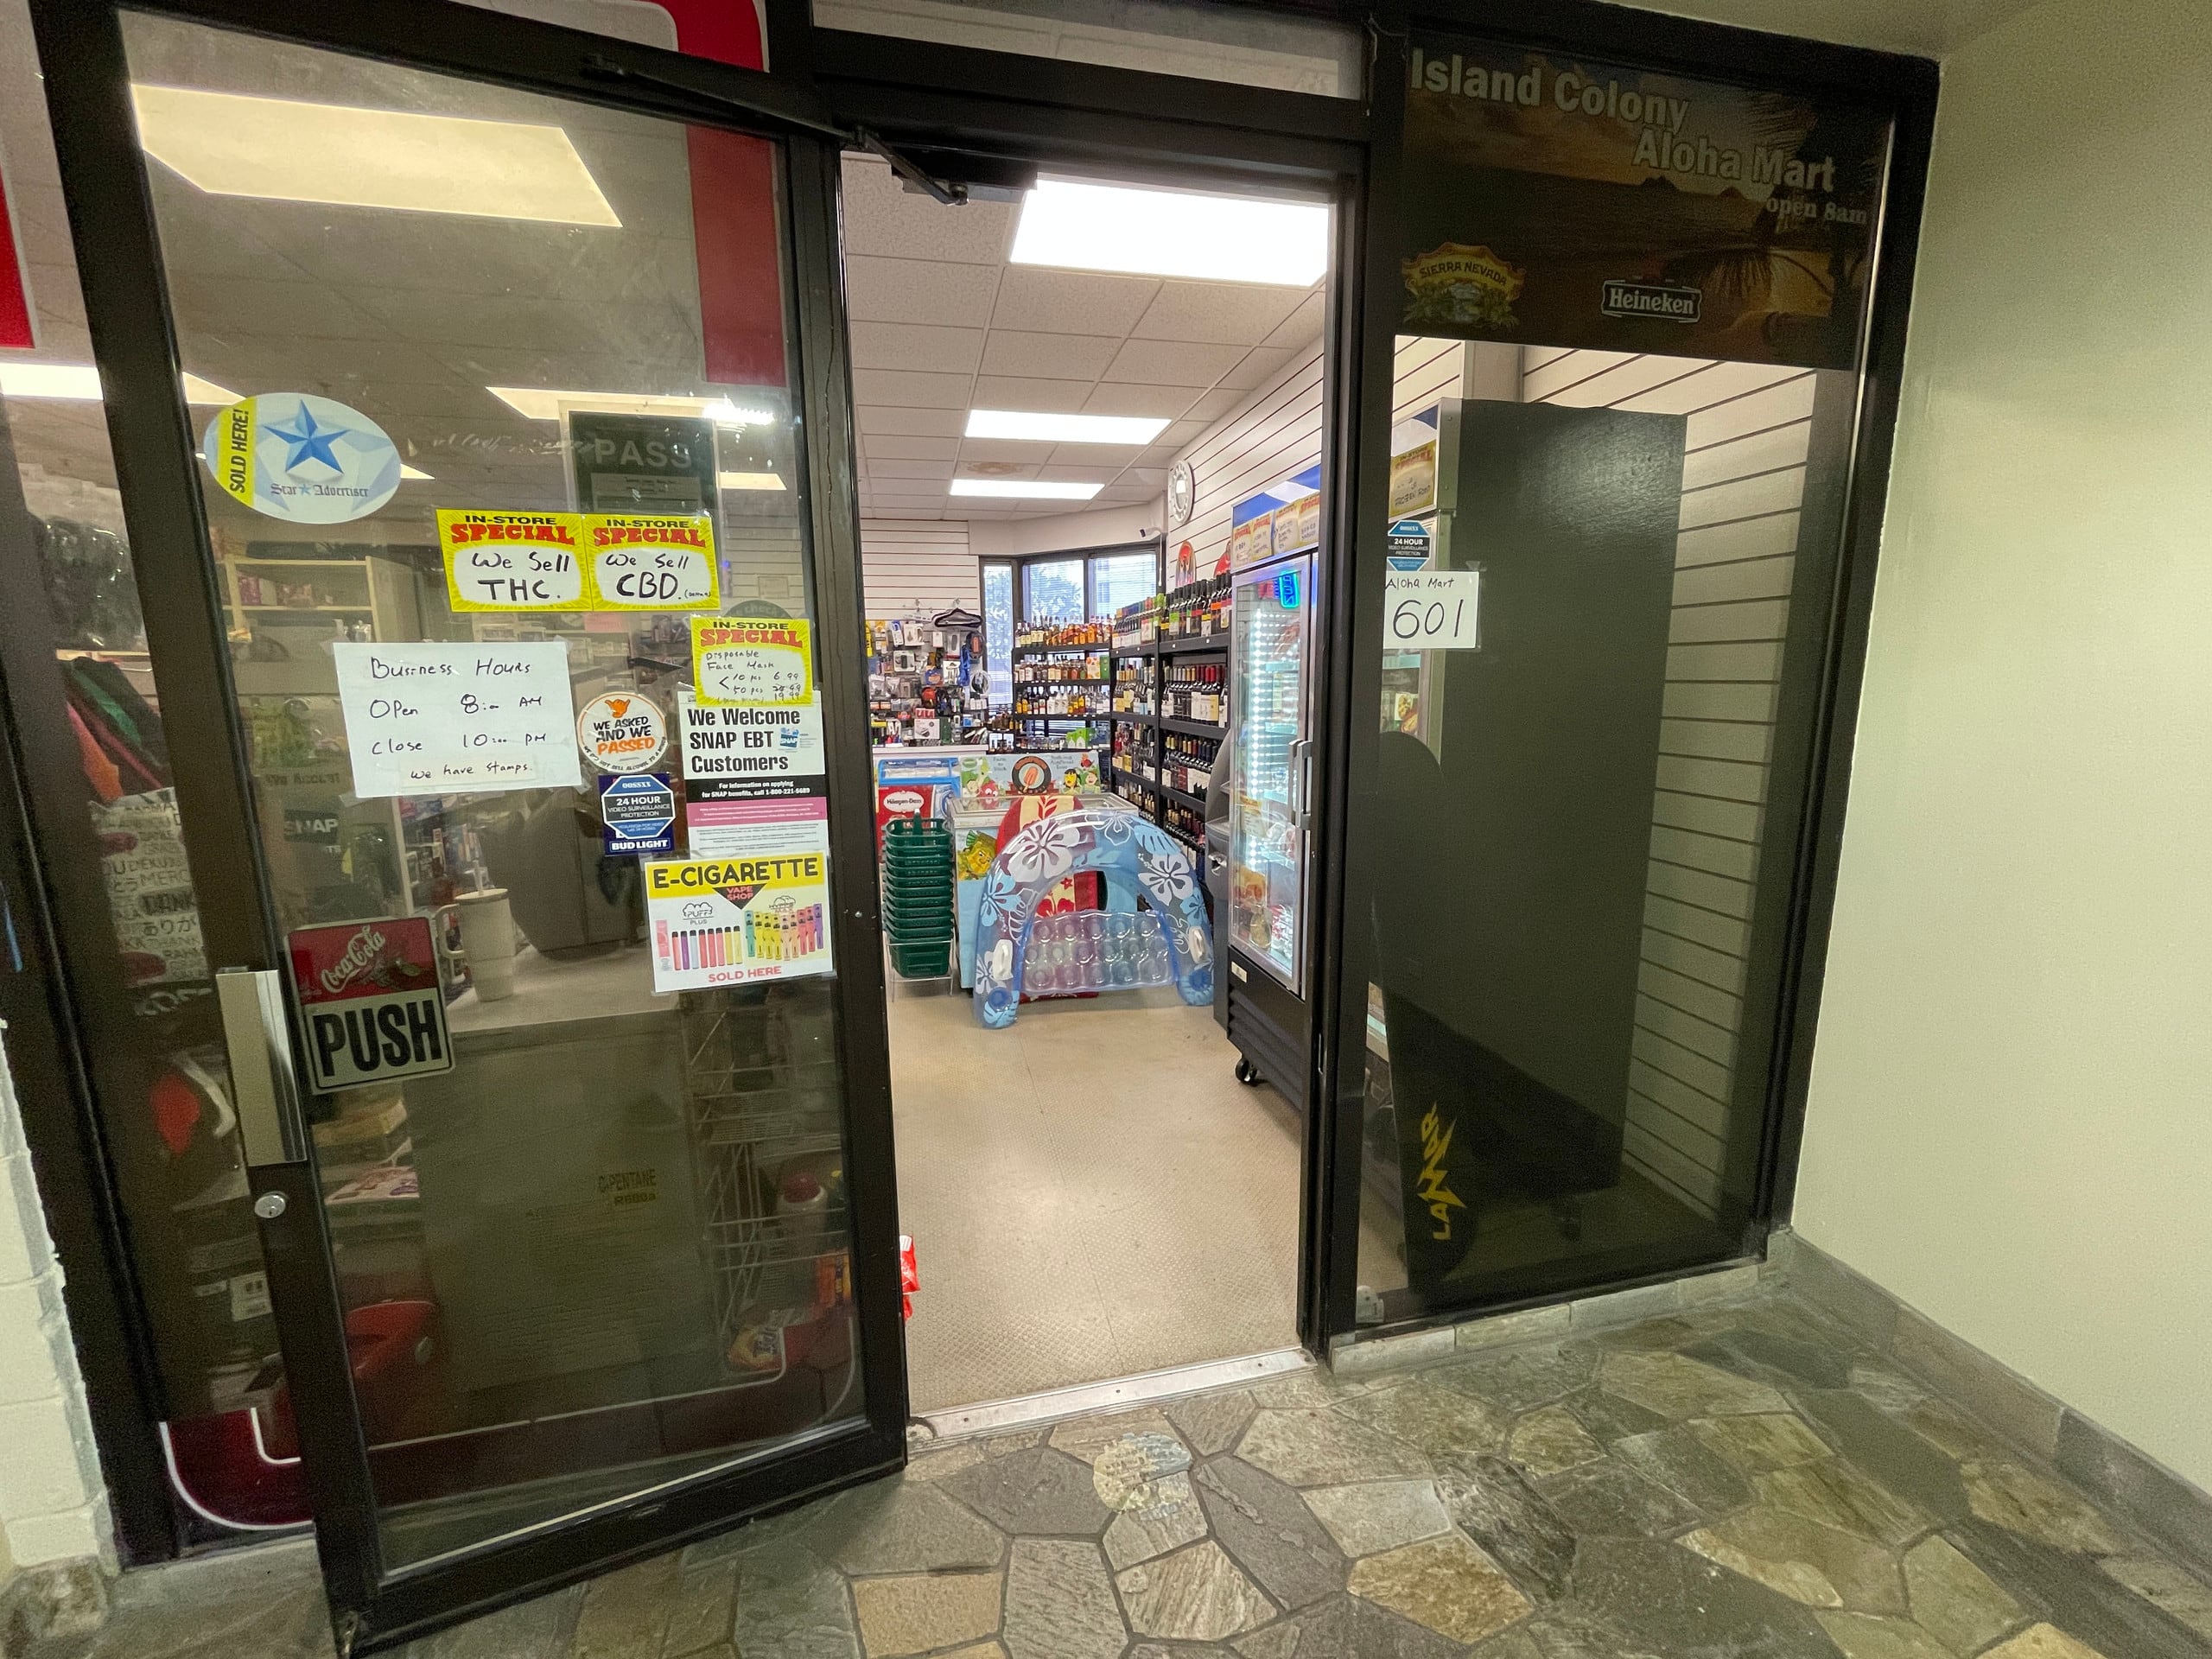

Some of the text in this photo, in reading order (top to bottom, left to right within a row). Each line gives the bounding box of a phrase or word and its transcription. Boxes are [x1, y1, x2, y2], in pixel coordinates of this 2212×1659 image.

[1411, 49, 1690, 135] Island Colony
[1632, 124, 1836, 193] Aloha Mart
[1766, 196, 1816, 220] open
[1420, 261, 1508, 285] SIERRA NEVADA
[1609, 288, 1694, 315] Heineken
[230, 409, 250, 493] SOLD HERE!
[594, 439, 692, 467] PASS
[270, 483, 297, 496] Star
[465, 515, 556, 525] IN-STORE
[607, 518, 690, 529] IN-STORE
[452, 524, 575, 545] SPECIAL
[594, 527, 706, 548] SPECIAL
[1385, 577, 1455, 591] Aloha Mart
[713, 621, 788, 630] IN-STORE
[1393, 599, 1465, 639] 601
[700, 629, 803, 648] SPECIAL
[707, 662, 733, 671] Face
[594, 716, 648, 731] WE ASKED
[687, 709, 800, 726] We Welcome
[596, 726, 652, 742] AND WE
[690, 731, 773, 749] SNAP EBT
[597, 737, 656, 756] PASSED
[443, 764, 474, 775] have
[691, 755, 788, 772] Customers
[616, 796, 661, 806] 24 HOUR
[611, 838, 669, 851] BUD LIGHT
[653, 857, 819, 889] E-CIGARETTE
[726, 885, 753, 893] VAPE
[727, 892, 753, 901] SHOP
[709, 966, 782, 982] SOLD HERE
[313, 1000, 442, 1077] PUSH
